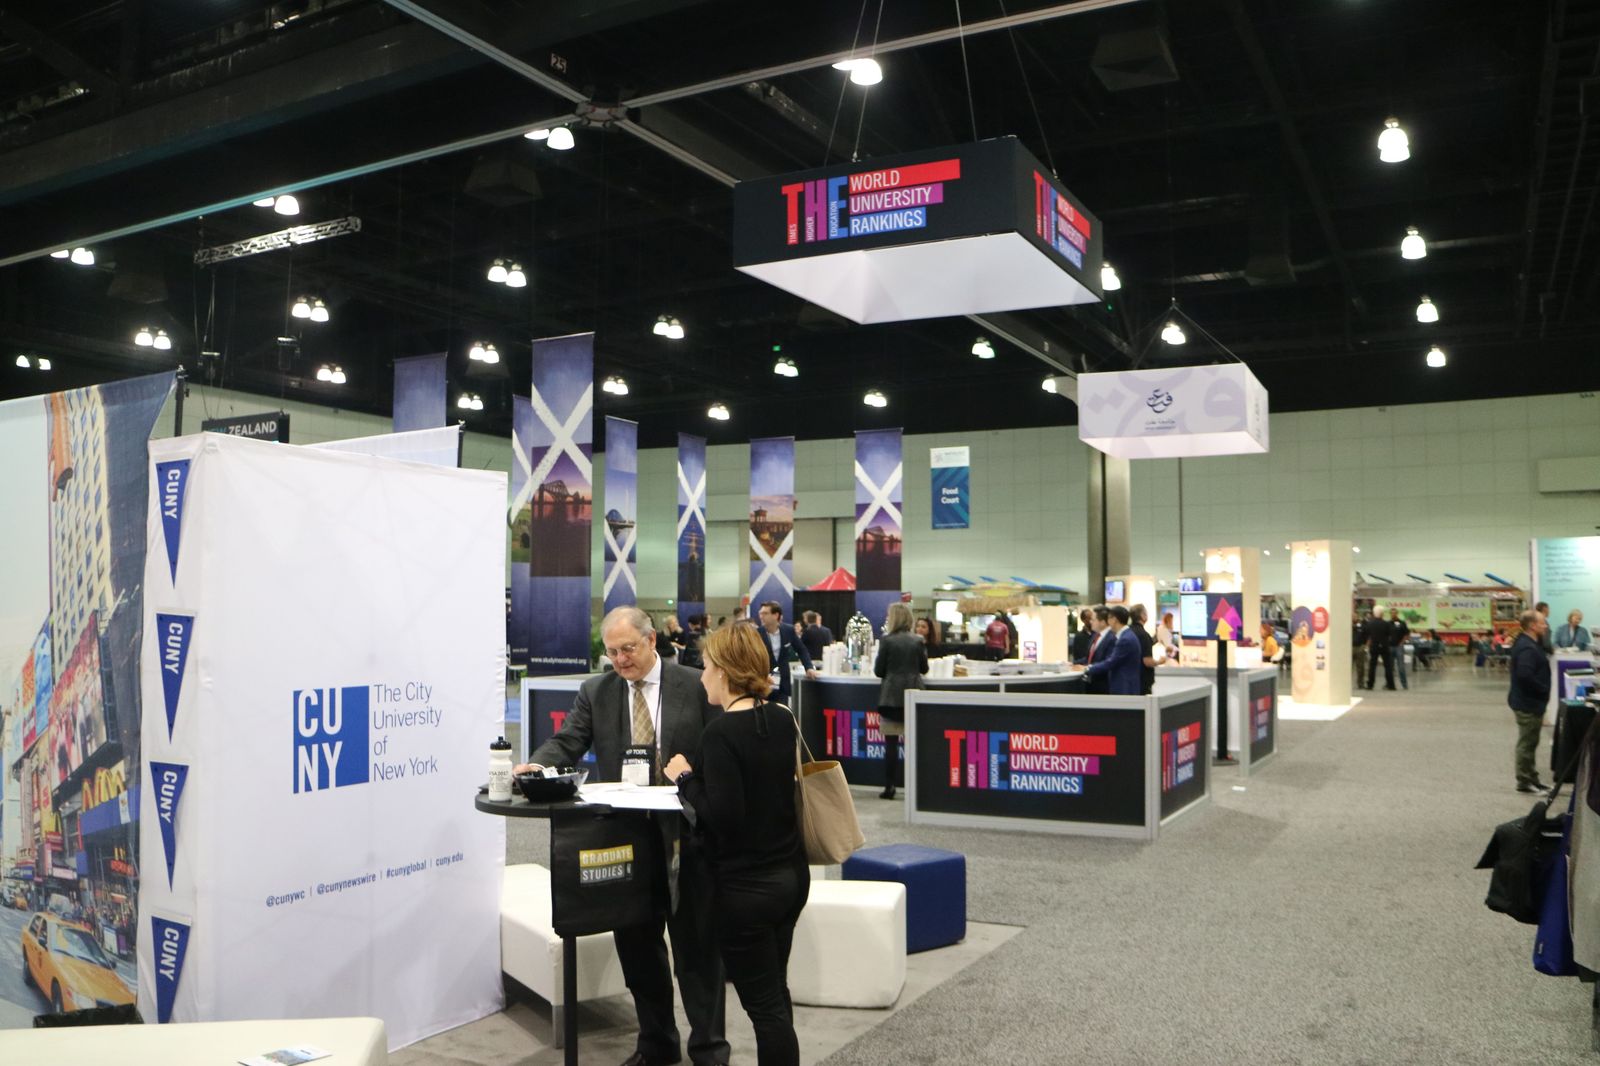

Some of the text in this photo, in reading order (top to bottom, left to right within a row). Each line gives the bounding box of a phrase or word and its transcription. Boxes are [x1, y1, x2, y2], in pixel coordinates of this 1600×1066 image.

[552, 54, 566, 72] 25
[850, 170, 900, 192] WORLD
[781, 175, 849, 245] THE
[850, 187, 932, 213] UNIVERSITY
[789, 223, 797, 243] TIMES
[806, 216, 815, 241] HIGHER
[851, 209, 923, 235] RANKINGS
[228, 421, 277, 436] ZEALAND
[164, 468, 181, 519] CUNY
[164, 622, 184, 675] CUNY
[374, 682, 432, 704] The City
[373, 706, 443, 730] University
[373, 735, 388, 756] of
[823, 709, 865, 758] THE
[1010, 734, 1058, 751] WORLD
[373, 755, 438, 782] New York
[944, 730, 1008, 789] THE
[990, 754, 998, 788] EDUCATION
[1011, 754, 1089, 772] UNIVERSITY
[1011, 774, 1079, 793] RANKINGS
[160, 770, 177, 823] CUNY
[582, 848, 631, 865] GRADUATE
[266, 851, 464, 907] @cunywc @cunynewswire #cunyglobal cuny.edu
[582, 865, 623, 881] STUDIES
[160, 927, 180, 981] CUNY
